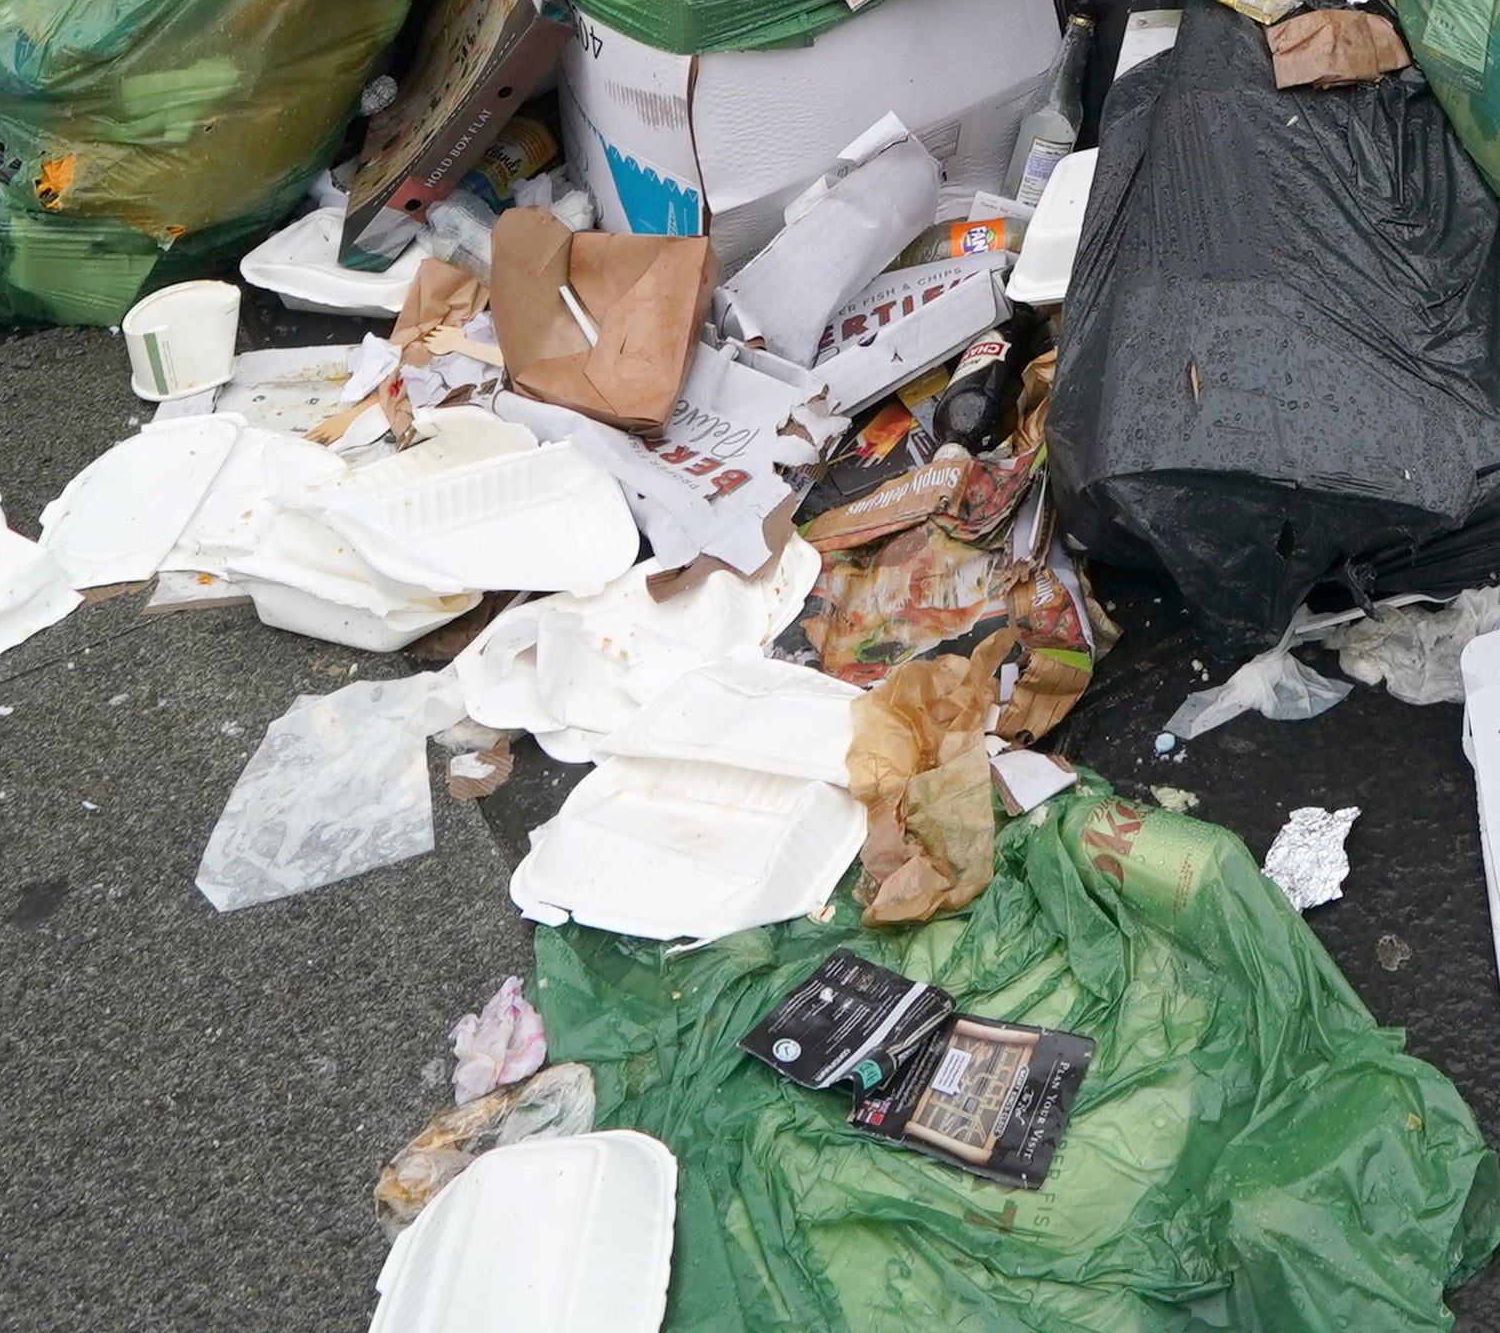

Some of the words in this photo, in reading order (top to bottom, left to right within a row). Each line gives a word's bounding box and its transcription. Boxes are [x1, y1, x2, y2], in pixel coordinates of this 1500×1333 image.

[424, 157, 453, 189] HOLD
[452, 135, 472, 158] BOX
[469, 108, 492, 135] FLAT
[862, 287, 896, 307] FISH
[900, 283, 911, 292] &
[916, 267, 963, 285] CHIPS
[901, 464, 962, 501] Simply
[1049, 1061, 1072, 1103] PLAN
[1035, 1102, 1060, 1130] YOUR
[1023, 1129, 1045, 1160] VISIT
